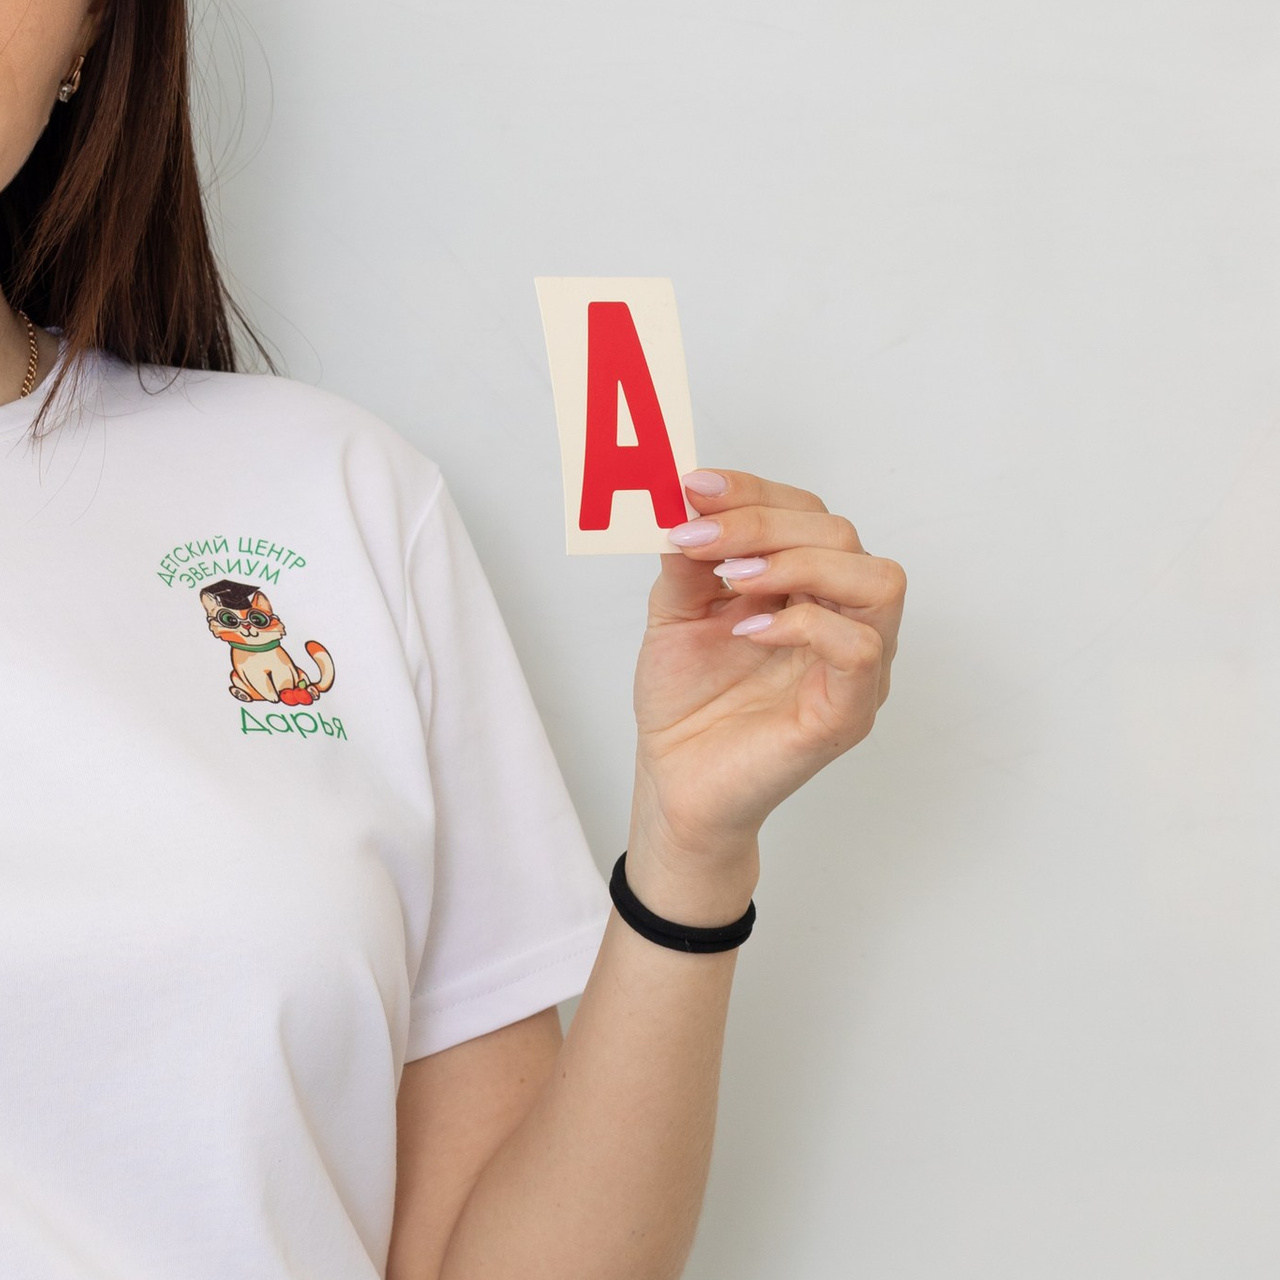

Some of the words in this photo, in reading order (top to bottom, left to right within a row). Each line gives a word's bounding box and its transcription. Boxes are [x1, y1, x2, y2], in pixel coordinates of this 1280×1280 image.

[157, 535, 229, 588] ДЕТСКИЙ
[238, 536, 307, 570] ЦЕНТР
[179, 558, 282, 589] ЭВЕЛИУМ
[240, 706, 348, 741] Дарья
